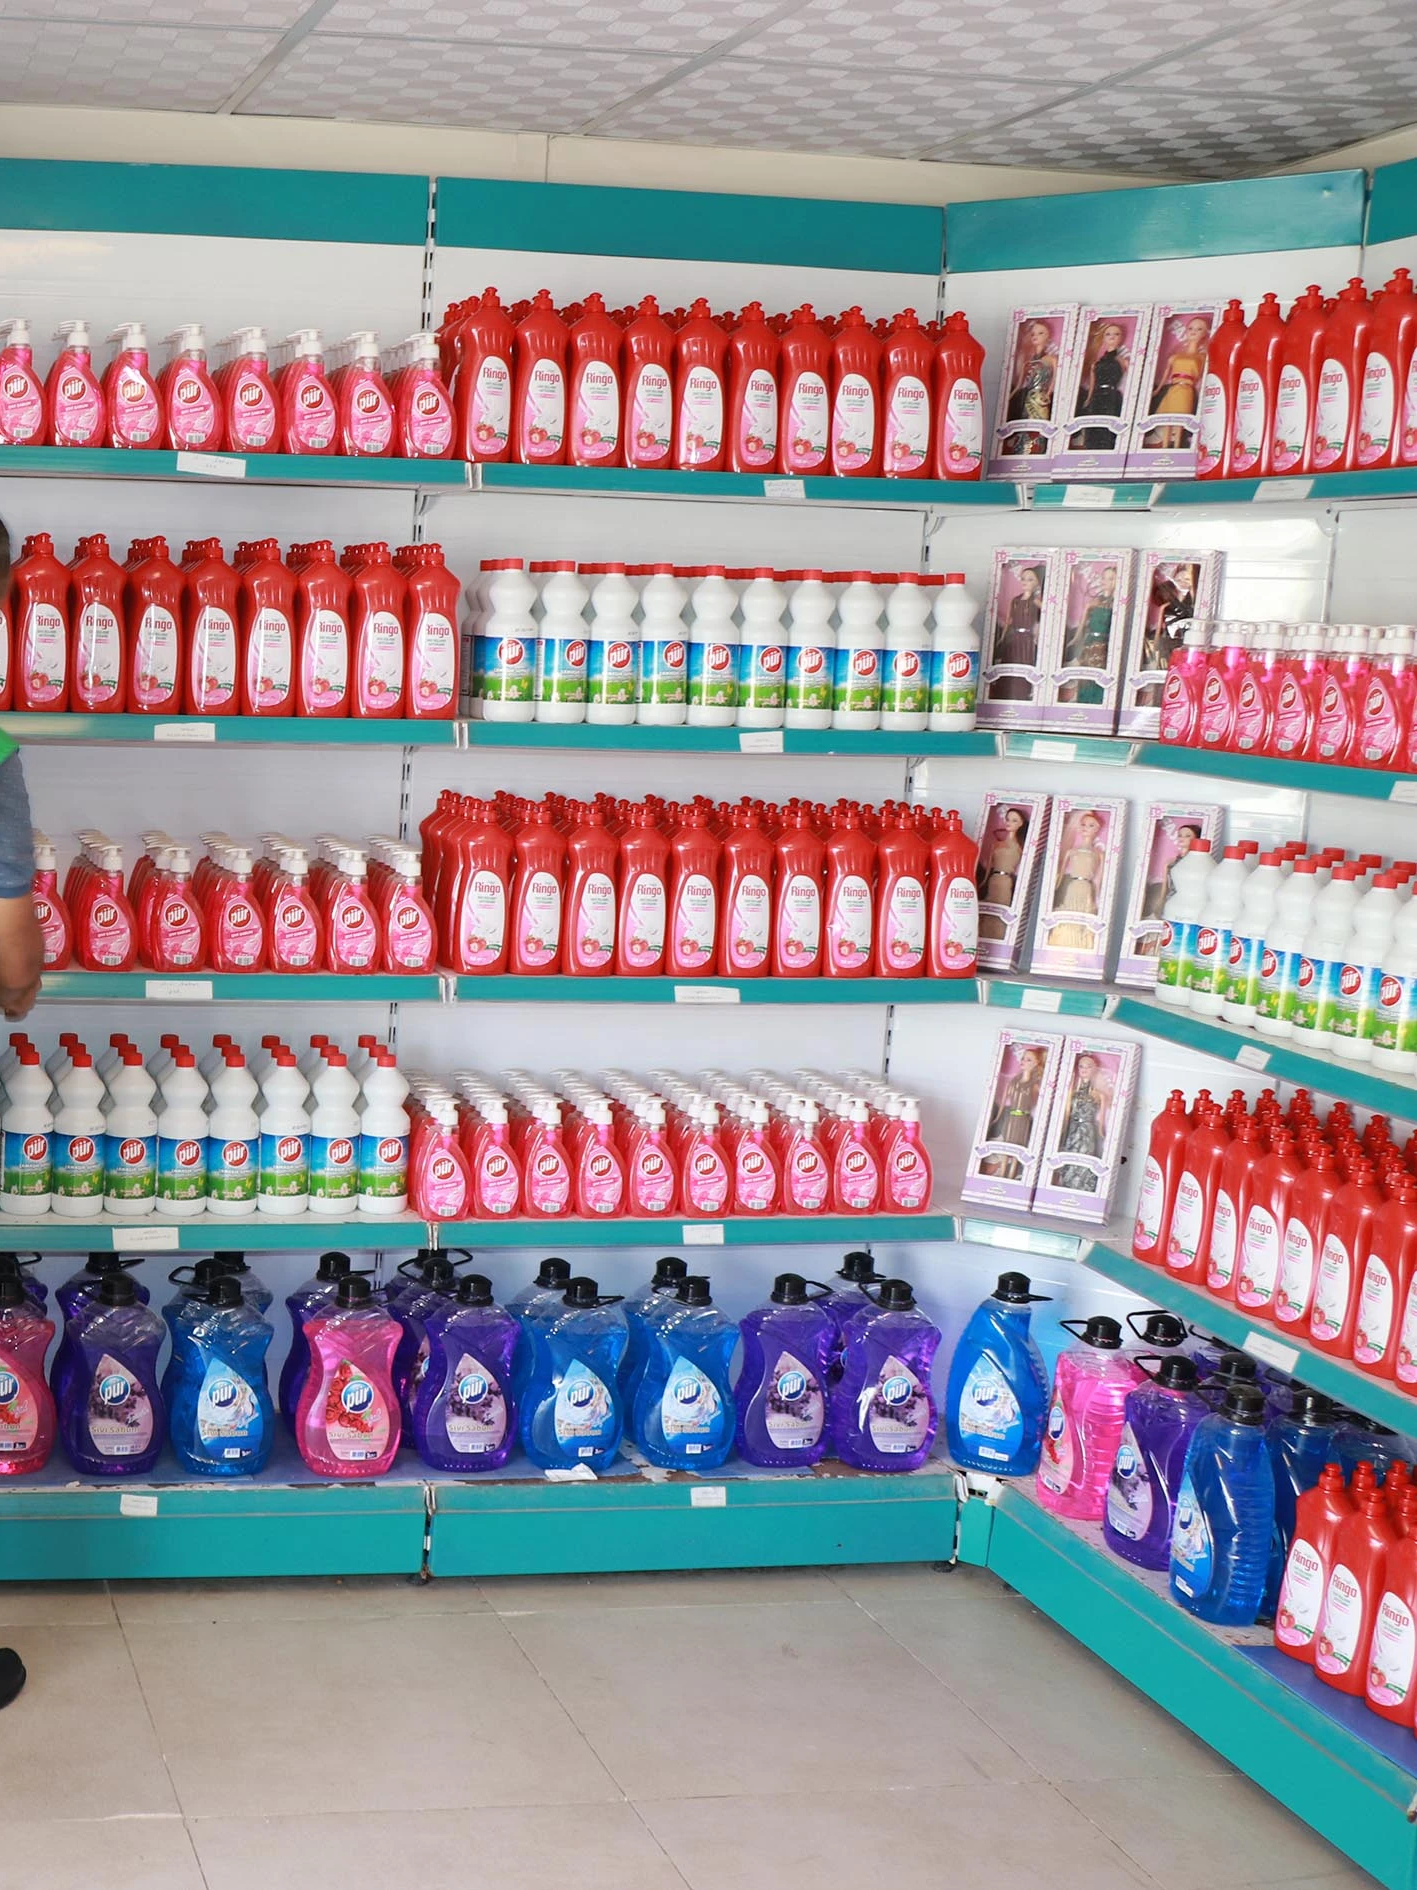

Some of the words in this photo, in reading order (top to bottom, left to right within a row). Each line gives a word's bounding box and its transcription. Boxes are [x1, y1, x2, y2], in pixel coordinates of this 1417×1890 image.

[483, 368, 507, 382] Ringo
[534, 370, 560, 386] Ringo
[585, 372, 612, 387] Ringo
[642, 375, 667, 389] Ringo
[6, 378, 26, 397] pür
[63, 379, 83, 397] pür
[180, 382, 199, 400] pür
[690, 377, 716, 392] Ringo
[752, 380, 774, 394] Ringo
[798, 383, 823, 397] Ringo
[842, 385, 868, 400] Ringo
[242, 385, 261, 403] pür
[303, 388, 321, 406] pür
[359, 393, 378, 411] pür
[419, 394, 438, 412] pür
[898, 387, 924, 402] Ringo
[954, 390, 978, 405] Ringo
[373, 621, 398, 636] Ringo
[611, 646, 630, 666] pür
[763, 652, 780, 670] pür
[854, 655, 874, 674] pür
[475, 882, 500, 896] Ringo
[532, 883, 557, 897] Ringo
[587, 883, 611, 898] Ringo
[637, 883, 661, 898] Ringo
[687, 884, 711, 899] Ringo
[742, 885, 766, 900] Ringo
[792, 884, 816, 899] Ringo
[843, 885, 868, 900] Ringo
[896, 886, 921, 901] Ringo
[950, 887, 974, 902] Ringo
[97, 907, 115, 925] pür
[167, 905, 186, 923] pür
[231, 907, 249, 925] pür
[283, 907, 302, 925] pür
[344, 908, 363, 926] pür
[398, 908, 417, 926] pür
[27, 1138, 46, 1158] pür
[72, 1140, 91, 1159] pür
[123, 1142, 142, 1161] pür
[179, 1143, 198, 1163] pür
[225, 1143, 245, 1162] pür
[281, 1139, 300, 1158] pür
[332, 1140, 351, 1159] pür
[382, 1140, 401, 1159] pür
[436, 1161, 453, 1177] pür
[489, 1158, 505, 1175] pür
[540, 1157, 557, 1173] pür
[593, 1157, 610, 1174] pür
[643, 1156, 660, 1173] pür
[696, 1156, 713, 1173] pür
[744, 1155, 761, 1172] pür
[799, 1155, 816, 1171] pür
[847, 1154, 864, 1171] pür
[898, 1154, 914, 1171] pür
[104, 1379, 126, 1404] pür
[212, 1382, 233, 1407] pür
[462, 1378, 485, 1403] pür
[569, 1383, 590, 1406] pür
[678, 1382, 698, 1404] pür
[782, 1375, 803, 1400] pür
[885, 1379, 908, 1404] pür
[346, 1385, 369, 1412] pür
[1293, 1549, 1319, 1573] Ringo
[1333, 1574, 1357, 1599] Ringo
[1383, 1602, 1409, 1627] Ringo
